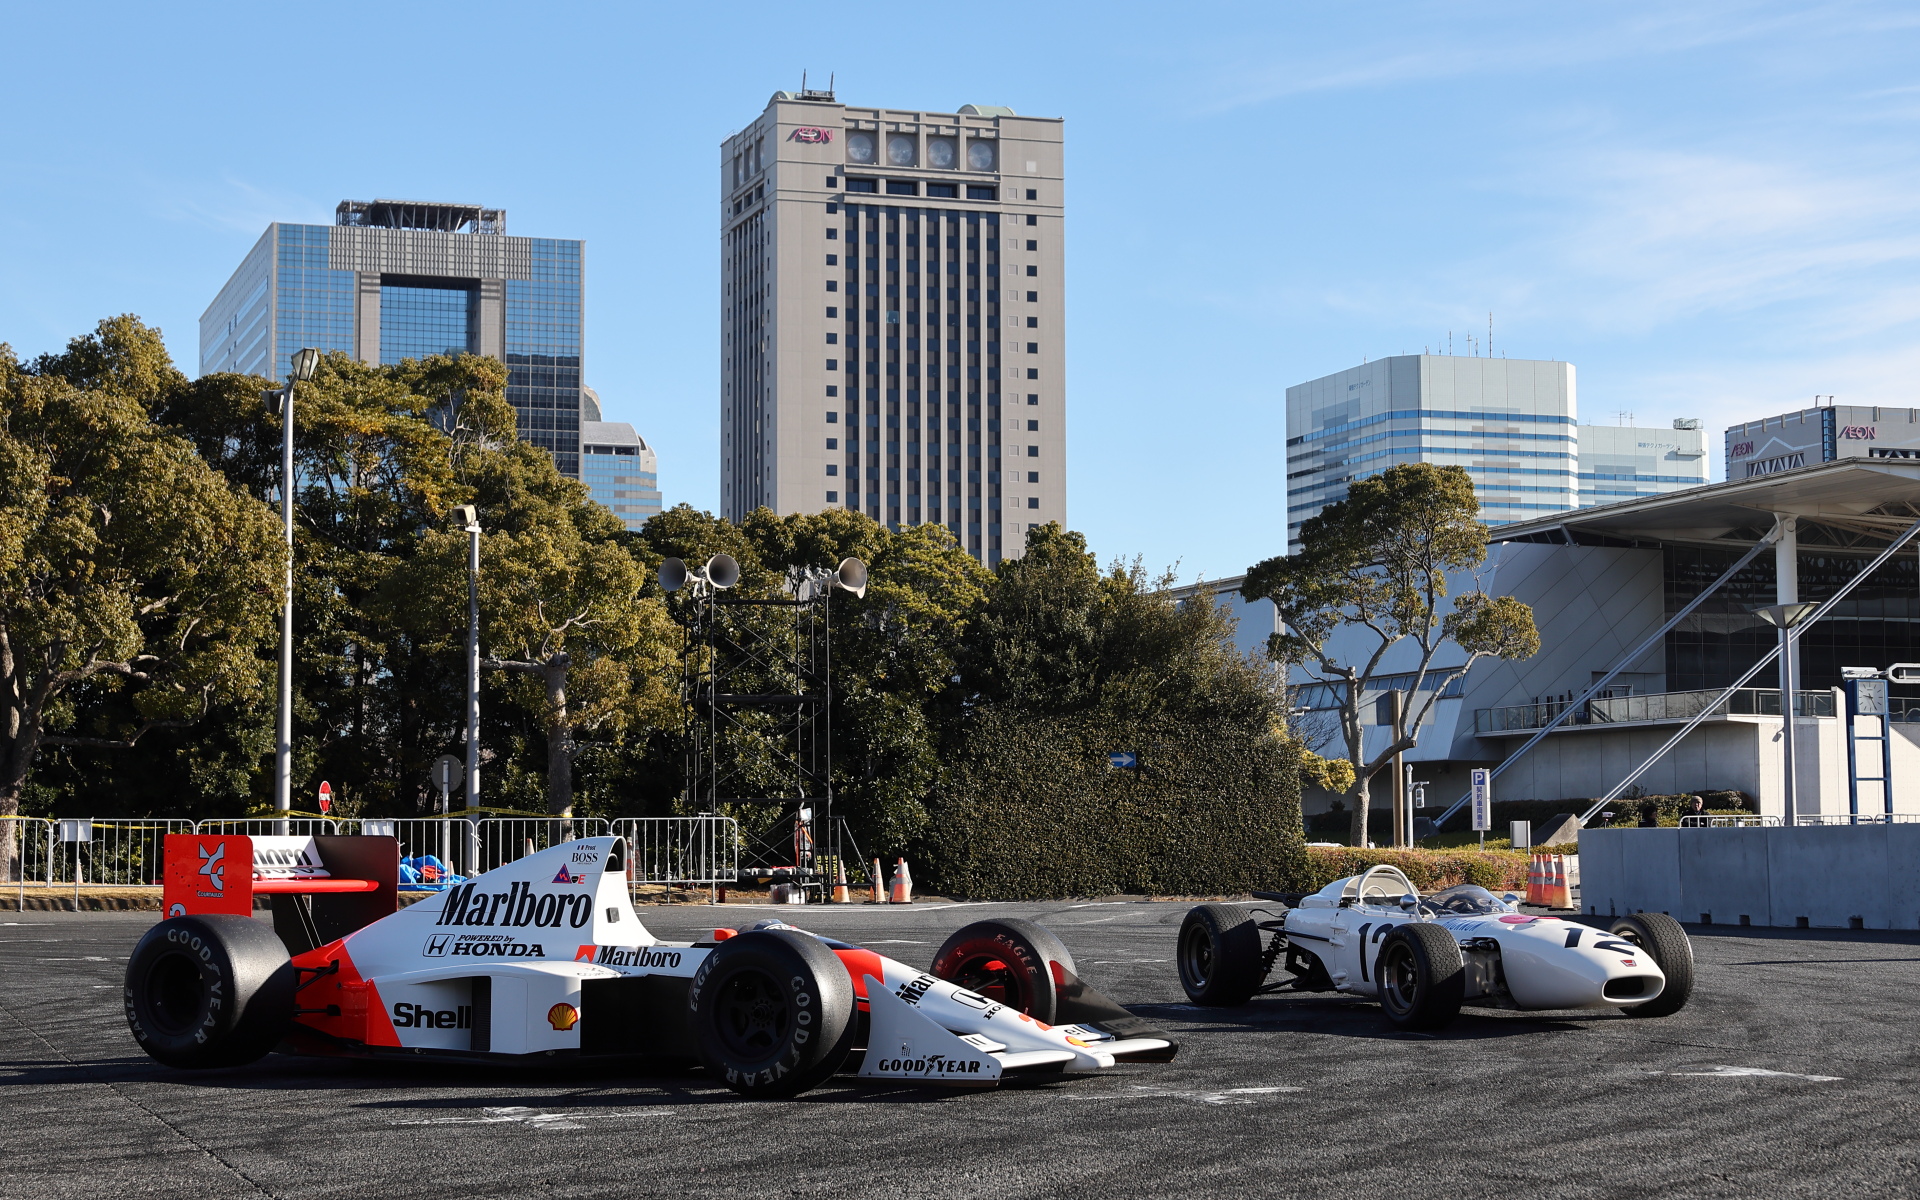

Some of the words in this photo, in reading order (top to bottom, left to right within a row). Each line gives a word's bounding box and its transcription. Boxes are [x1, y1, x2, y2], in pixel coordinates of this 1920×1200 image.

[1474, 772, 1484, 785] P
[571, 852, 599, 863] BOSS
[435, 881, 593, 929] Marlboro
[451, 942, 546, 957] HONDA
[457, 934, 504, 942] POWERED
[503, 935, 516, 943] by
[596, 945, 682, 968] Marlboro
[690, 953, 720, 1012] EAGLE
[125, 988, 149, 1042] EAGLE
[393, 1002, 472, 1029] Shell
